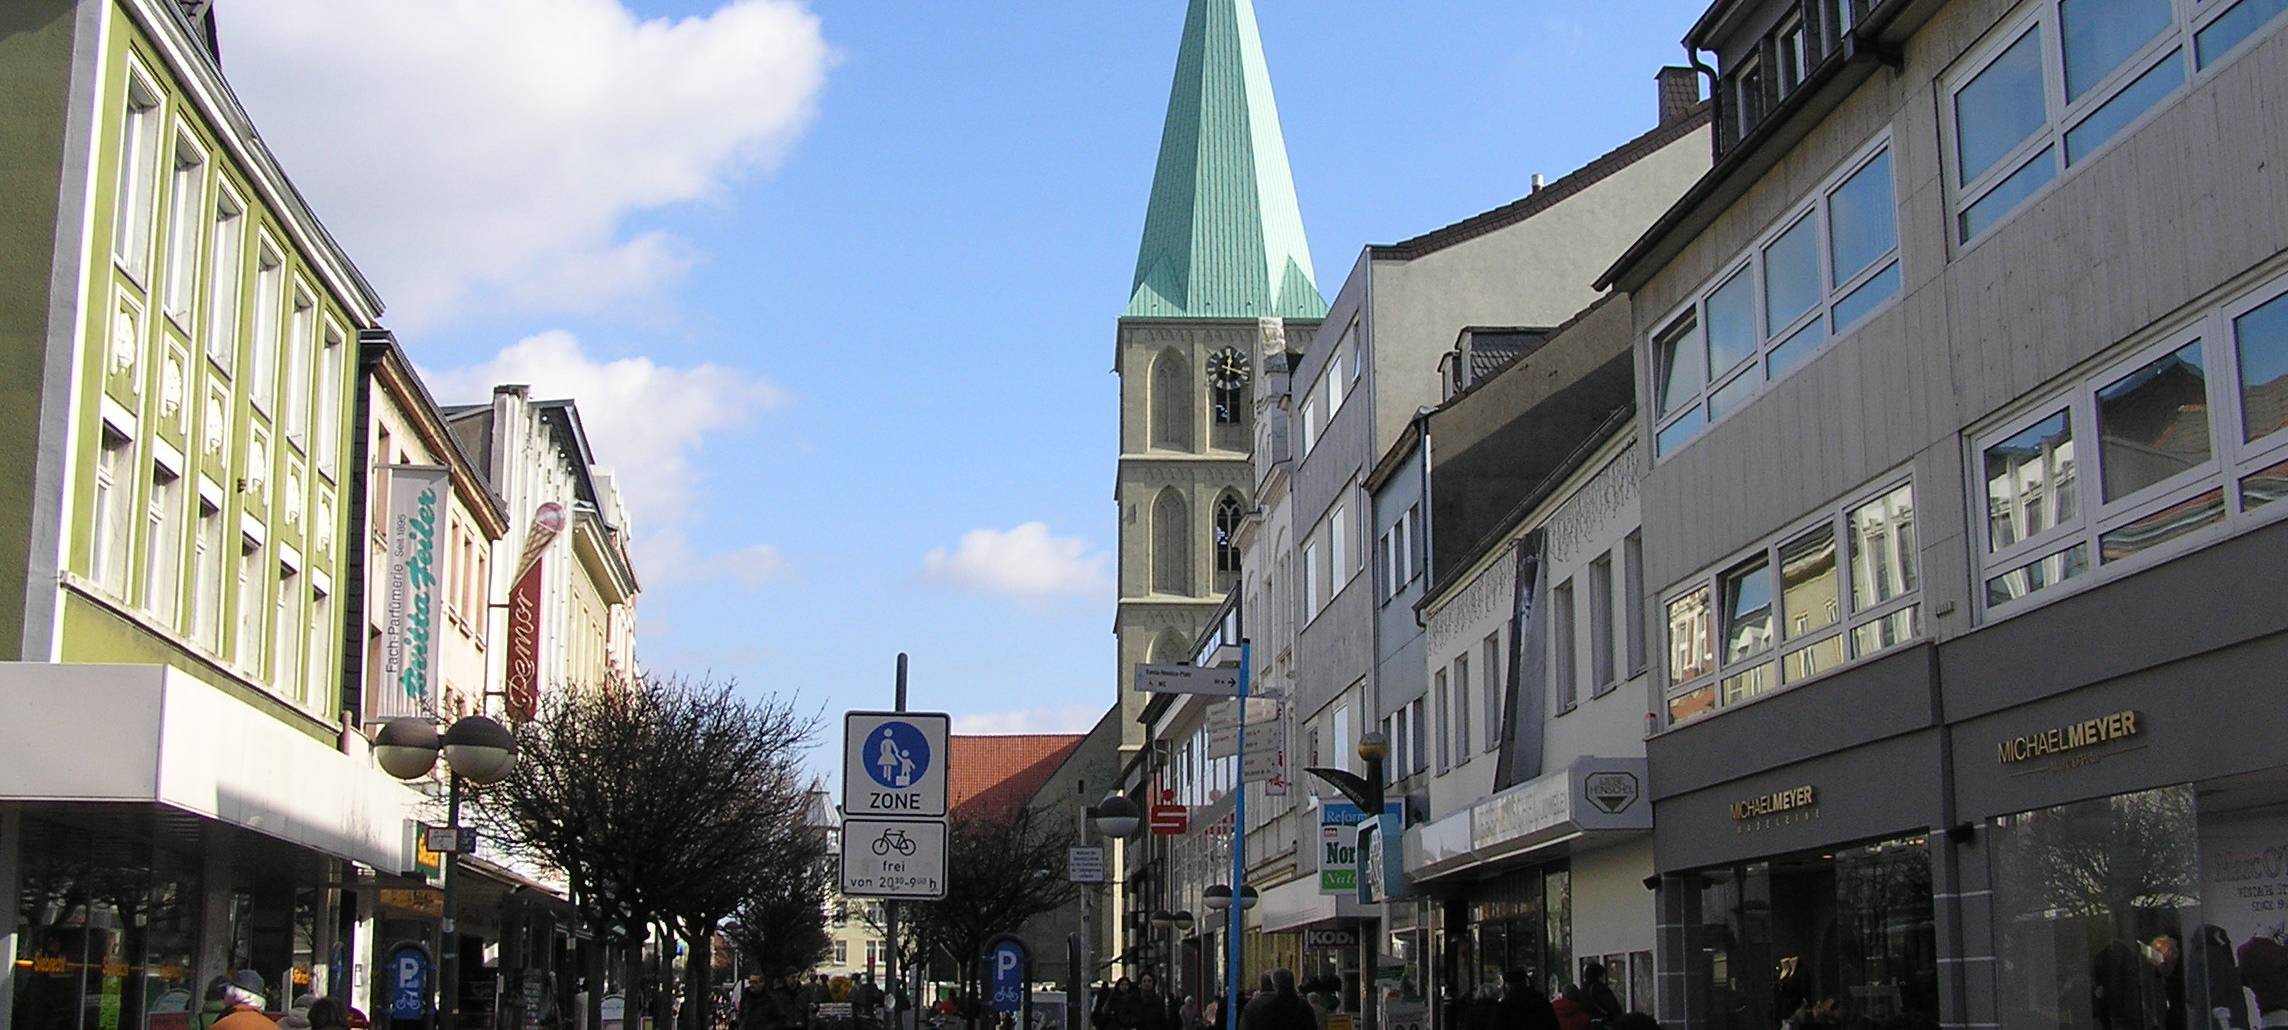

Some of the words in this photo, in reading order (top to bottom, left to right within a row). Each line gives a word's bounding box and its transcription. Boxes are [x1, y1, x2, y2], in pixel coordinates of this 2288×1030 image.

[394, 538, 405, 558] Seit
[386, 564, 403, 673] Fach-Parfümerie
[399, 592, 430, 698] Britta
[1997, 710, 2136, 764] MICHAELMEYER
[870, 792, 921, 810] ZONE
[1730, 784, 1813, 820] MICHAELMEYER
[883, 860, 905, 872] frei
[850, 879, 873, 888] von
[929, 879, 937, 889] h
[399, 957, 419, 988] P
[997, 949, 1016, 980] P
